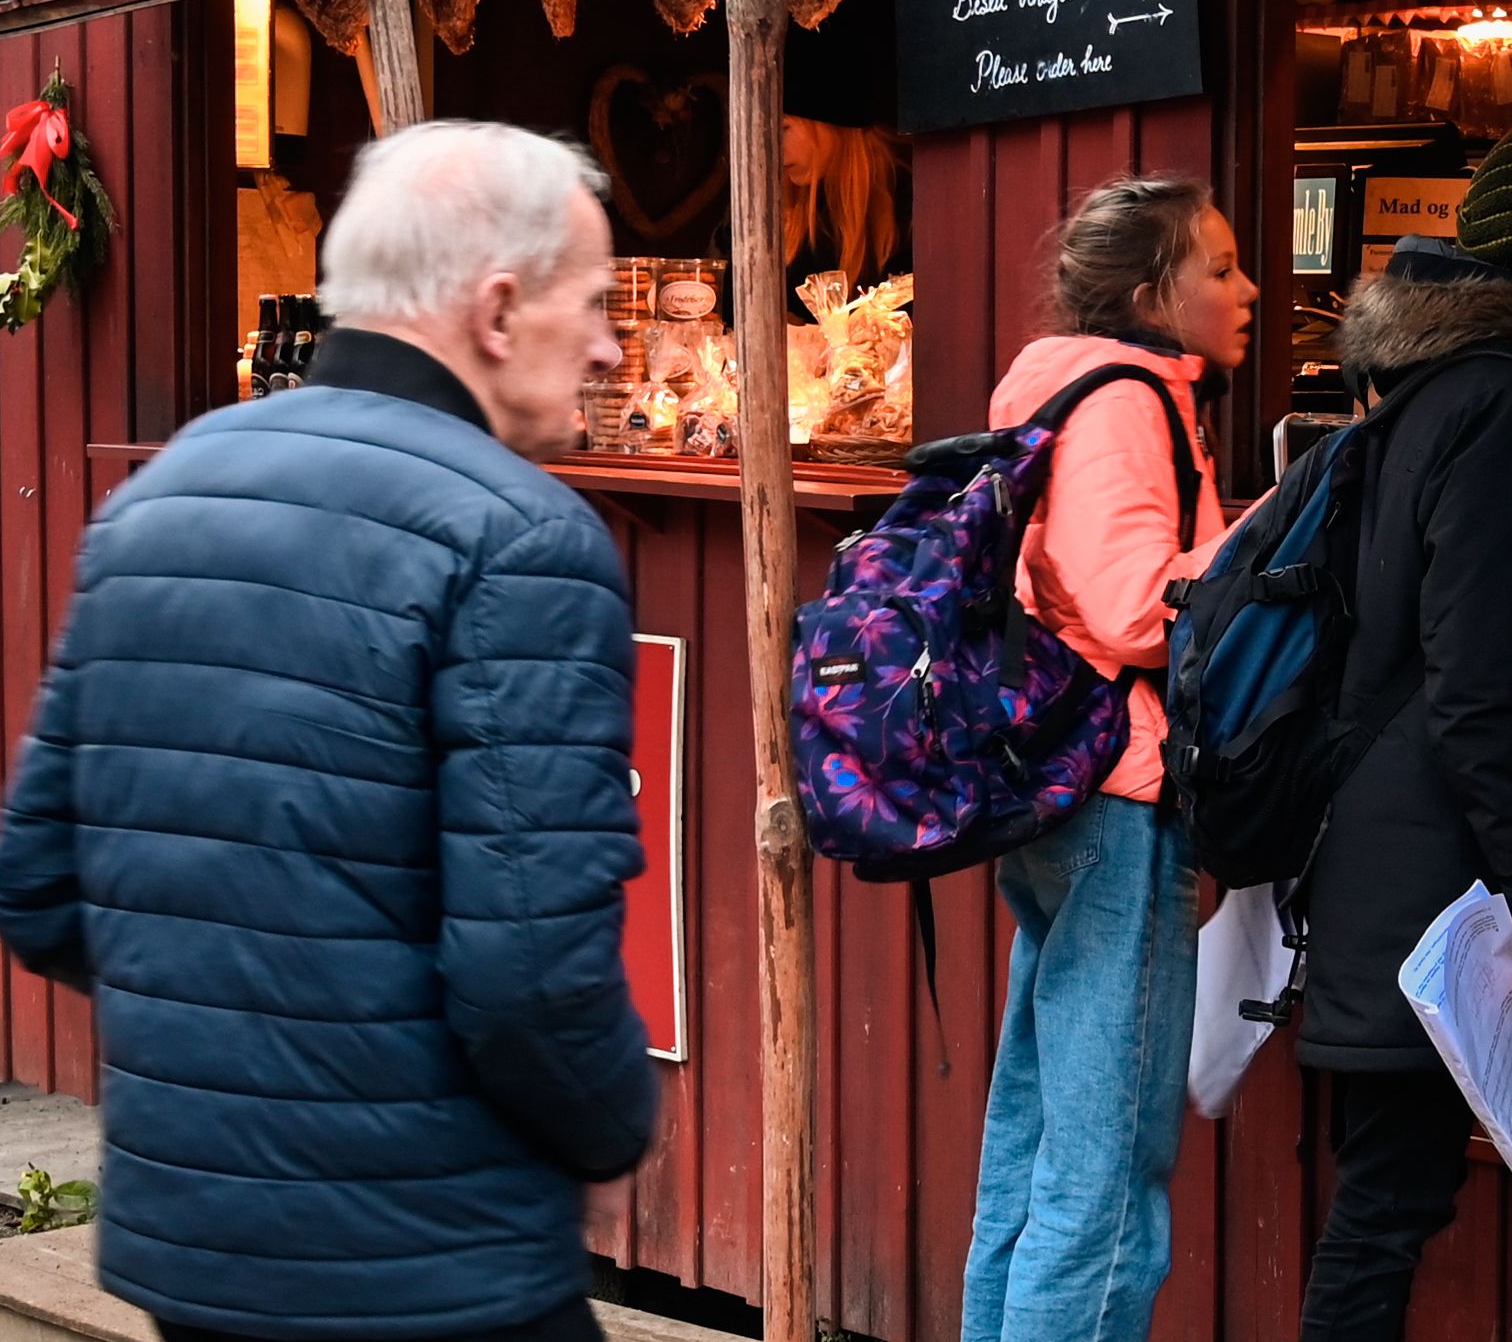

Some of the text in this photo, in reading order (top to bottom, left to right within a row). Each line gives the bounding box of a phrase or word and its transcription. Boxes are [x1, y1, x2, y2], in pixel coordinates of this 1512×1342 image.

[970, 44, 1113, 94] Please order here
[1315, 188, 1334, 267] By
[1379, 198, 1421, 215] Mad
[1427, 204, 1449, 219] og
